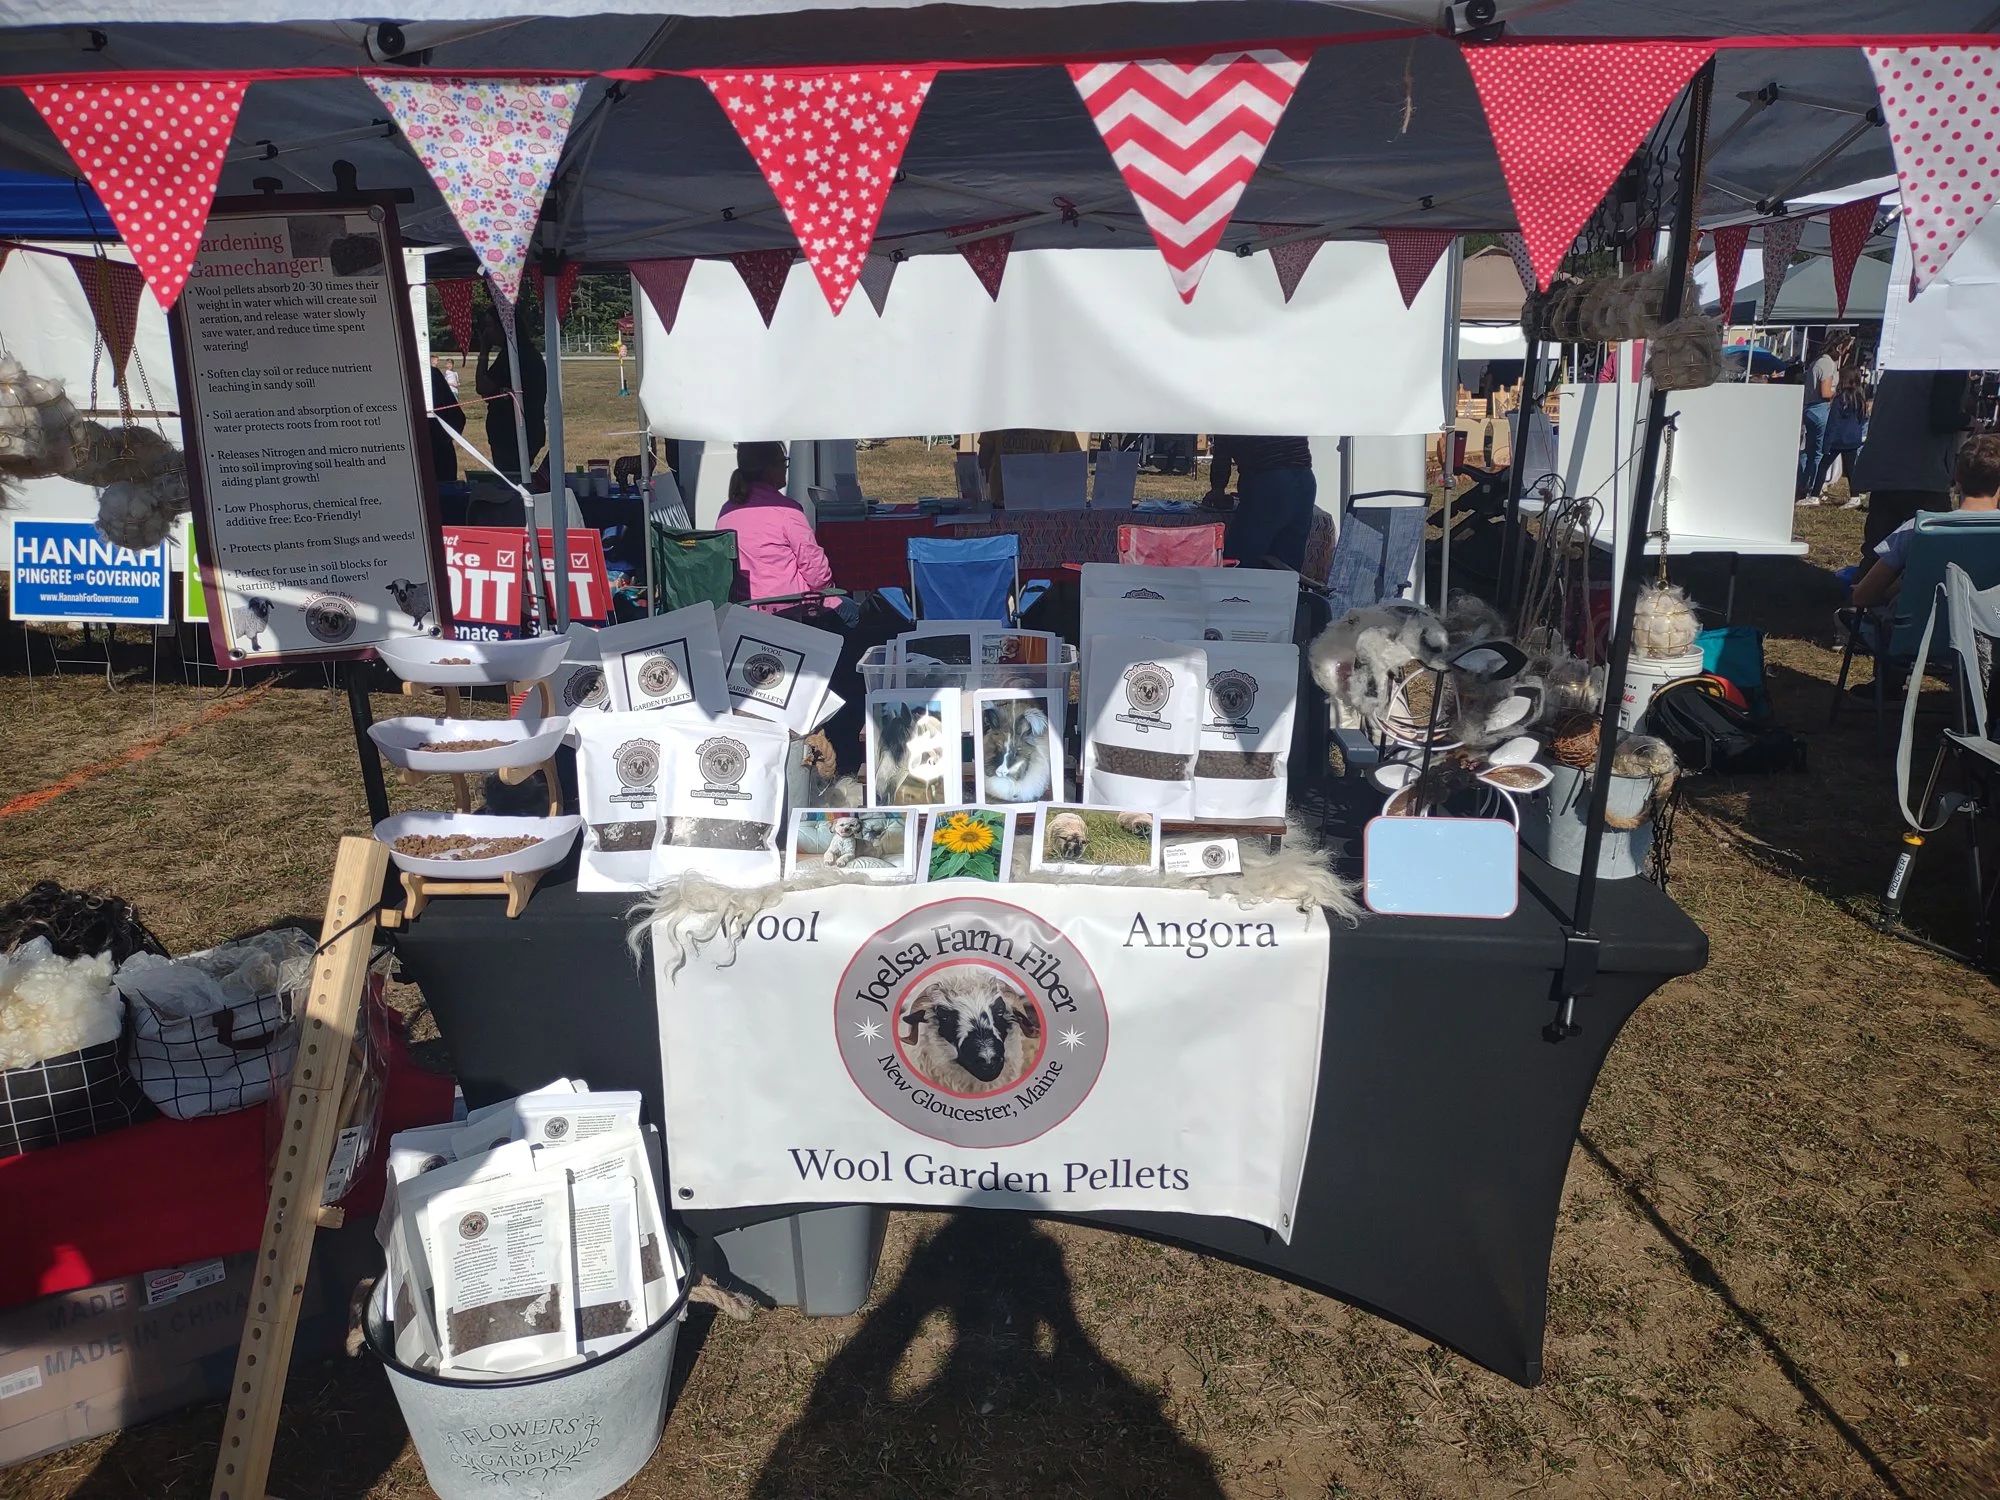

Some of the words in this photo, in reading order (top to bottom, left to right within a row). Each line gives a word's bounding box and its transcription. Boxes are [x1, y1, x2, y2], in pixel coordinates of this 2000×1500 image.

[201, 232, 284, 254] ardening
[190, 257, 324, 278] Gamechanger!
[195, 286, 220, 296] Wool
[224, 285, 256, 297] pellets
[258, 282, 290, 294] absorb
[326, 281, 354, 291] times
[356, 280, 380, 290] their
[197, 300, 229, 312] weight
[232, 300, 242, 310] in
[244, 298, 271, 308] water
[274, 295, 304, 307] which
[306, 294, 324, 306] will
[326, 295, 358, 306] create
[359, 294, 378, 304] soil
[200, 314, 242, 325] aeration,
[244, 312, 262, 322] and
[264, 310, 298, 321] release
[303, 310, 330, 320] water
[333, 308, 366, 320] slowly
[202, 329, 224, 338] save
[257, 325, 276, 336] and
[277, 324, 311, 335] reduce
[313, 323, 335, 333] time
[338, 323, 366, 334] spent
[203, 340, 249, 352] watering!
[208, 368, 240, 379] Soften
[241, 367, 261, 380] clay
[264, 366, 281, 376] soil
[283, 367, 294, 376] or
[296, 364, 330, 375] reduce
[332, 363, 372, 374] nutrient
[208, 382, 250, 393] leaching
[252, 382, 262, 390] in
[264, 380, 293, 392] sandy
[296, 378, 316, 389] soil!
[212, 410, 232, 420] Soil
[234, 408, 275, 419] aeration
[277, 406, 296, 416] and
[298, 404, 350, 418] absorption
[353, 404, 364, 413] of
[366, 404, 398, 412] excess
[214, 424, 242, 433] water
[244, 422, 284, 434] protects
[286, 420, 312, 430] roots
[314, 418, 338, 428] from
[340, 418, 362, 428] root
[364, 416, 382, 426] rot!
[218, 450, 260, 460] Releases
[262, 448, 306, 460] Nitrogen
[308, 446, 326, 456] and
[329, 445, 358, 456] micro
[360, 442, 406, 453] nutrients
[220, 464, 240, 474] into
[242, 462, 260, 472] soil
[261, 461, 313, 474] improving
[314, 459, 332, 469] soil
[334, 457, 365, 468] health
[367, 456, 386, 466] and
[222, 477, 253, 488] aiding
[255, 475, 280, 488] plant
[282, 473, 320, 486] growth!
[224, 504, 246, 514] Low
[250, 502, 311, 514] Phosphorus,
[313, 498, 358, 510] chemical
[360, 496, 382, 506] free,
[226, 516, 267, 527] additive
[268, 514, 292, 525] free:
[294, 510, 362, 524] Eco-Friendly!
[230, 543, 272, 553] Protects
[274, 541, 304, 552] plants
[306, 538, 332, 548] from
[334, 536, 360, 547] Slugs
[362, 534, 380, 544] and
[382, 531, 416, 542] weeds!
[443, 534, 458, 545] ect
[18, 537, 161, 568] HANNAH
[446, 548, 480, 568] ke
[234, 567, 270, 578] Perfect
[272, 565, 288, 576] for
[290, 565, 306, 574] use
[308, 563, 318, 572] in
[320, 562, 338, 572] soil
[340, 560, 372, 570] blocks
[374, 558, 388, 568] for
[18, 568, 72, 584] PINGREE
[86, 570, 160, 588] GOVERNOR
[237, 581, 276, 592] starting
[278, 578, 308, 590] plants
[310, 576, 329, 586] and
[330, 572, 369, 584] flowers!
[40, 593, 138, 604] www.HannahForGovernor.com
[448, 566, 516, 622] OTT
[454, 625, 499, 642] enate
[644, 648, 667, 658] WOOL
[761, 645, 783, 658] WOOL
[633, 700, 661, 712] GARDEN
[661, 692, 691, 705] PELLETS
[728, 684, 753, 695] GARDEN
[754, 690, 785, 705] PELLETS
[1890, 858, 1906, 894] ROCKER
[719, 911, 820, 942] Wool
[1123, 912, 1278, 958] Angora
[856, 942, 931, 1012] Joelsa
[931, 924, 1014, 960] Farm
[1014, 942, 1077, 1014] Fiber
[878, 1054, 912, 1092] New
[911, 1089, 1018, 1122] Gloucester,
[1014, 1060, 1063, 1110] Maine
[788, 1148, 892, 1182] Wool
[904, 1154, 1049, 1193] Garden
[1063, 1158, 1190, 1193] Pellets
[49, 1286, 127, 1330] MADE
[44, 1331, 123, 1376] MADE
[134, 1319, 159, 1347] IN
[512, 1440, 528, 1452] &
[481, 1446, 564, 1467] GARDEN
